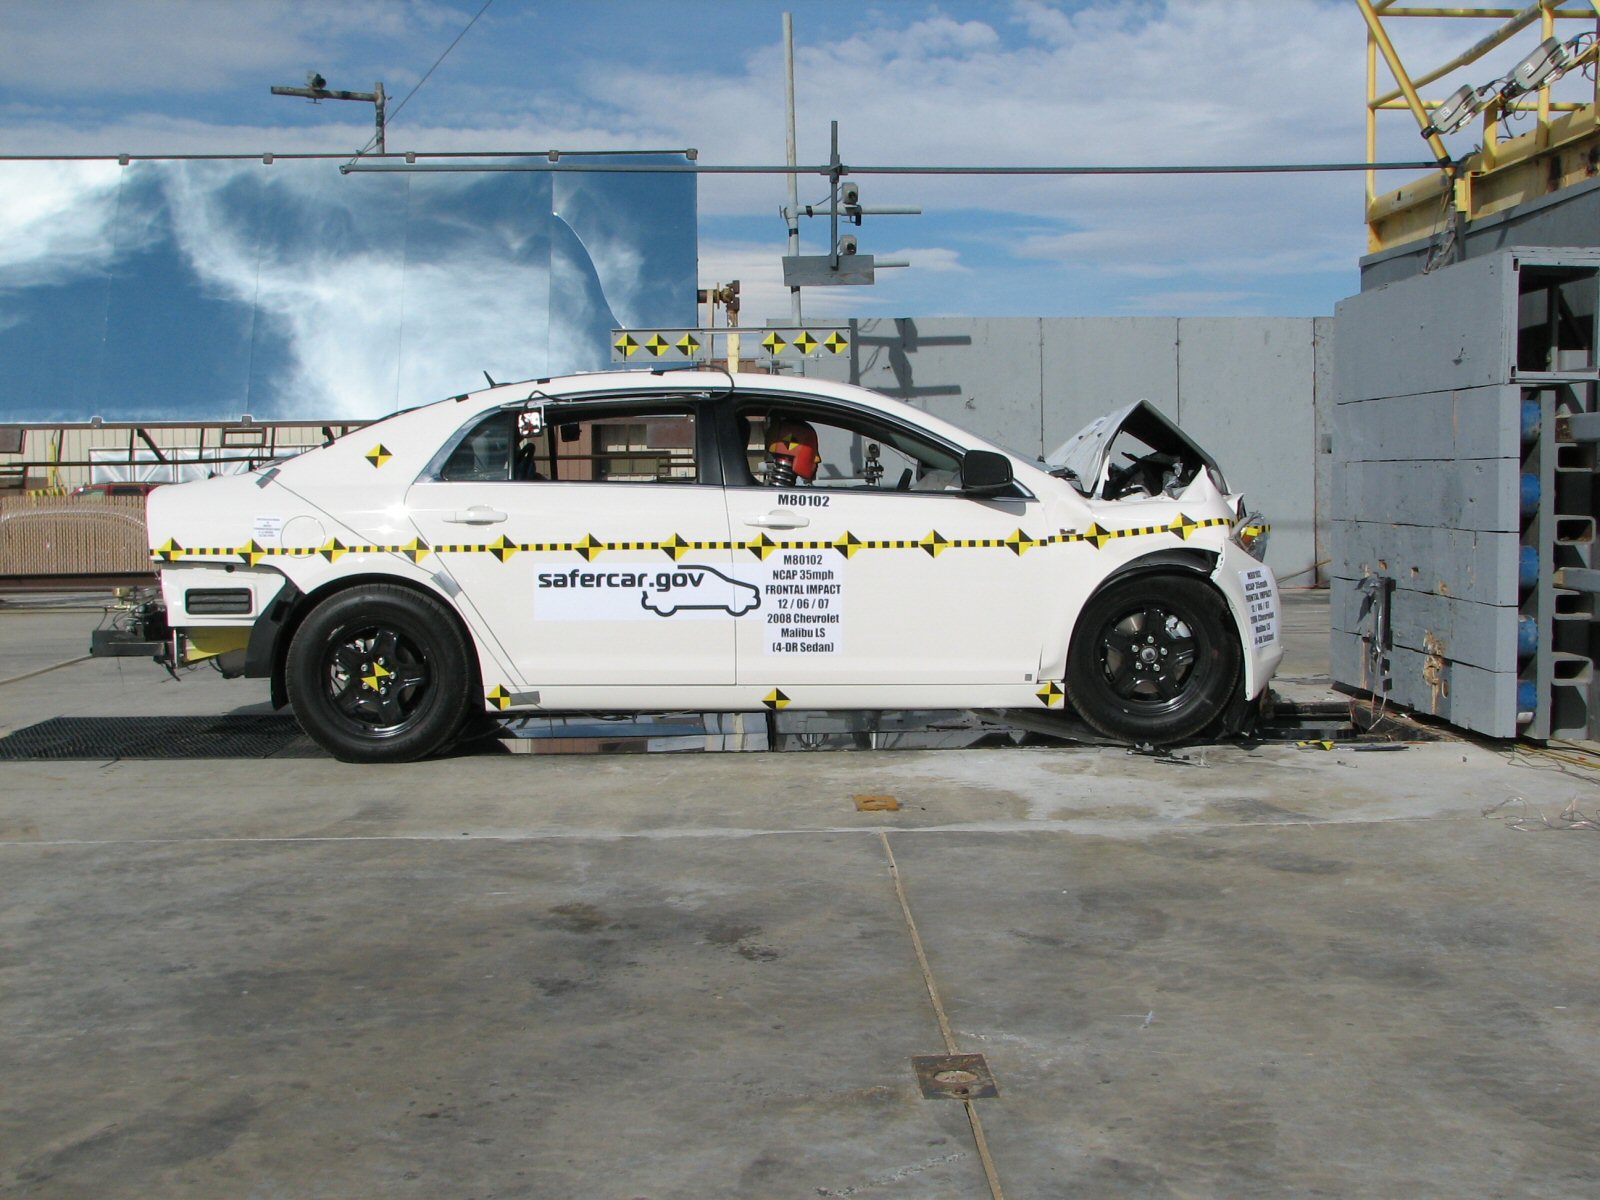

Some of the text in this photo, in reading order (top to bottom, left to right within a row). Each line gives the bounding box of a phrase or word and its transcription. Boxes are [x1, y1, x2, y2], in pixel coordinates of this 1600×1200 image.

[778, 494, 830, 507] M80102
[783, 554, 823, 566] M80102
[538, 569, 705, 592] safercar.gov
[772, 569, 834, 581] NCAP 35mph
[765, 584, 841, 595] FRONTAL IMPACT
[777, 599, 788, 609] 12
[796, 599, 809, 609] 06
[817, 599, 829, 609] 07
[767, 613, 839, 624] 2008 Chevrolet
[781, 628, 826, 638] Malibu LS
[772, 642, 834, 653] (4-DR Sedan)
